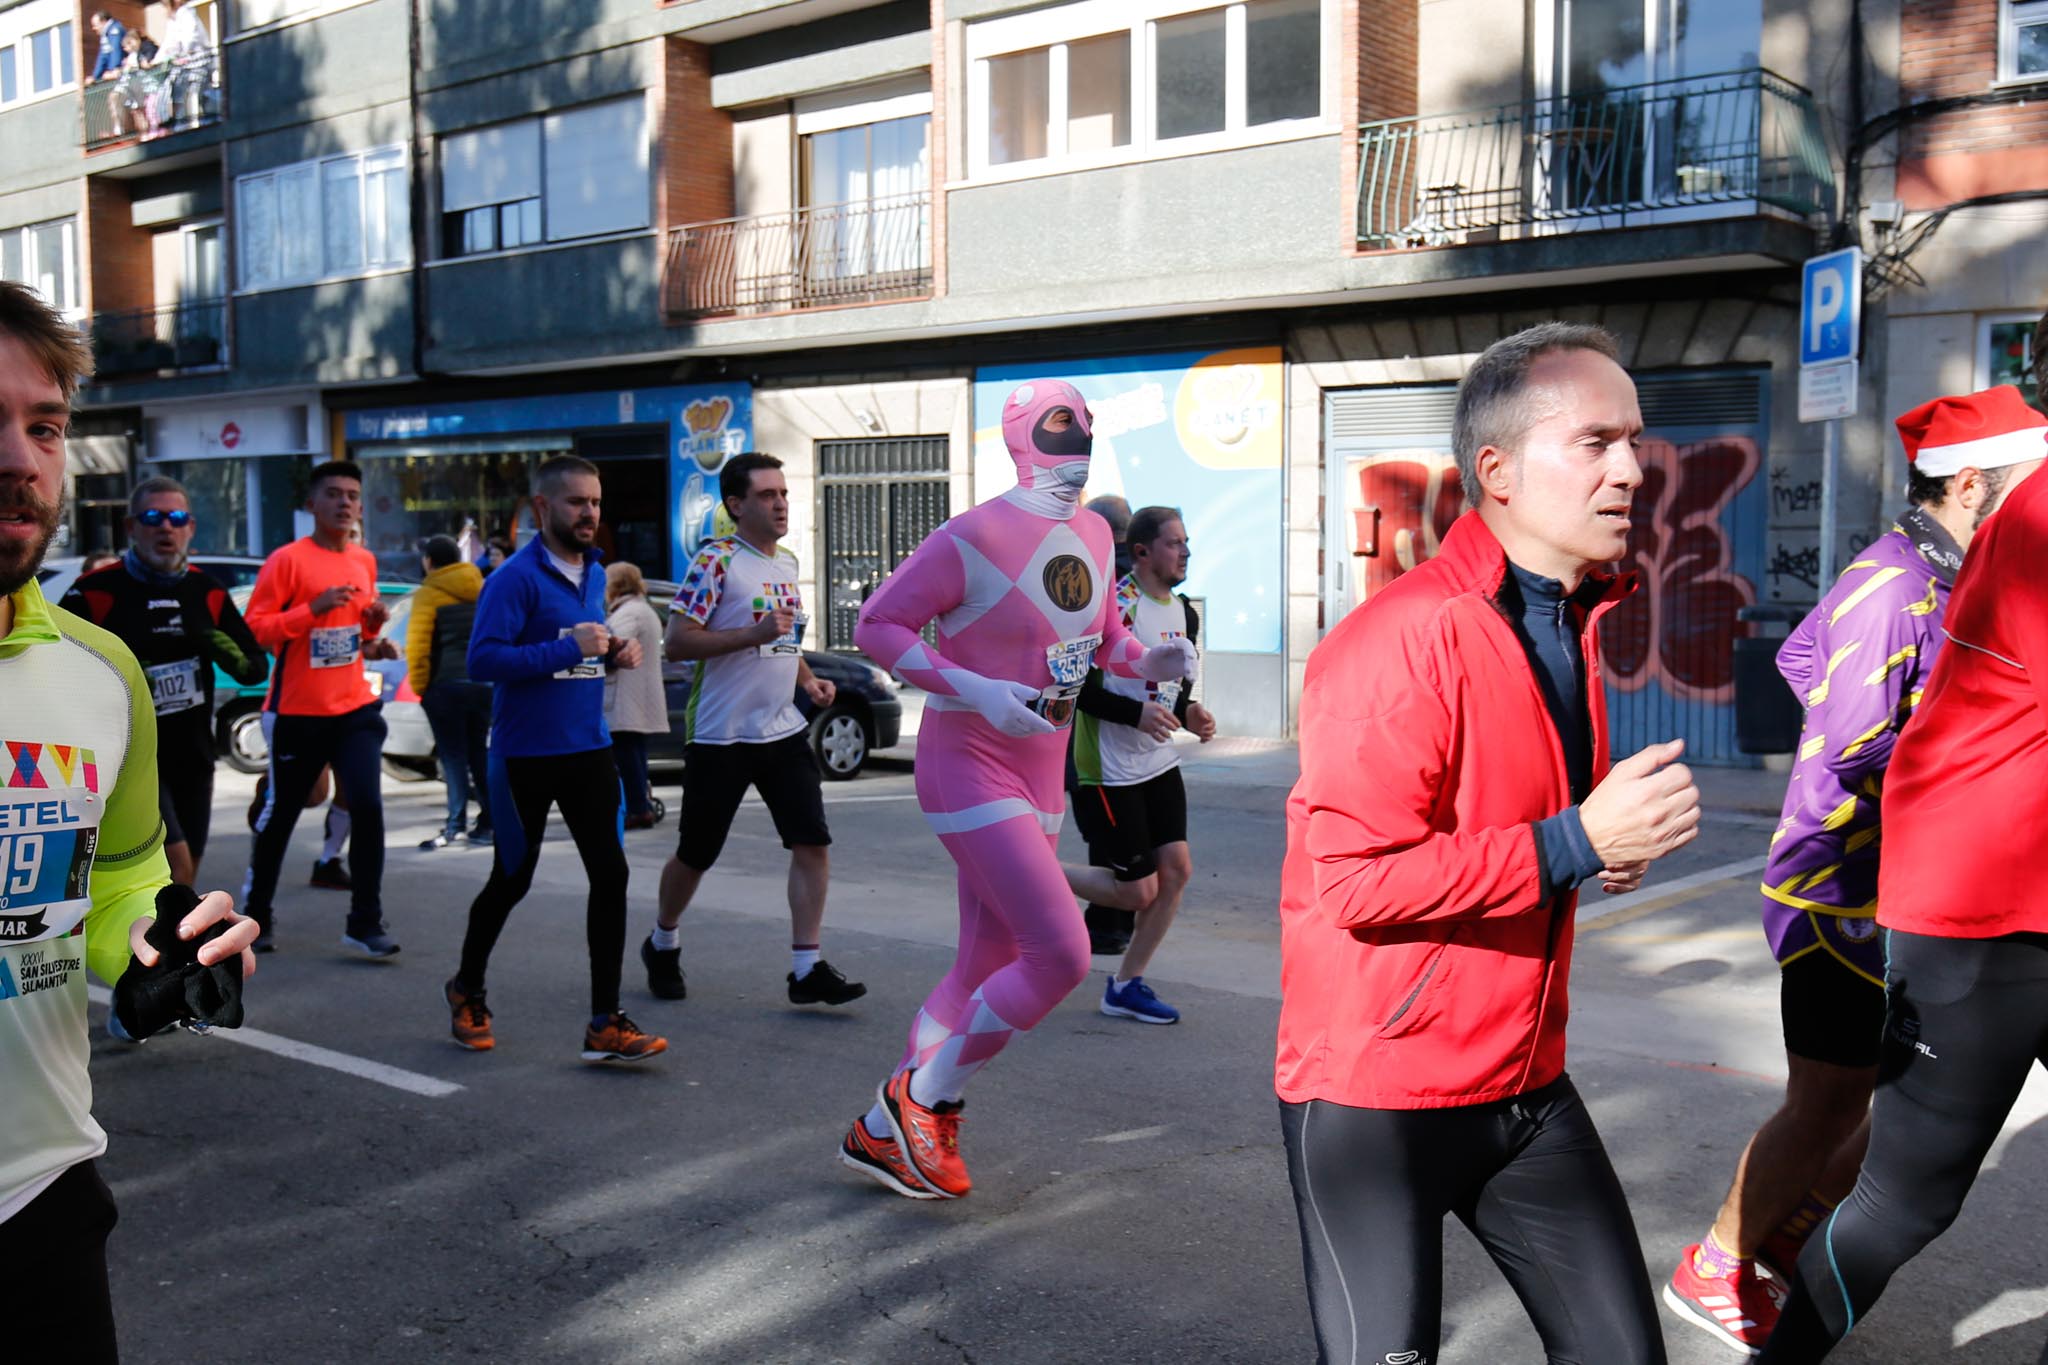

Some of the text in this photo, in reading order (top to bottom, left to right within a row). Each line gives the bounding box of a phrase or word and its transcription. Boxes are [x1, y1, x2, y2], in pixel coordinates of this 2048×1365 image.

[1810, 267, 1845, 353] P
[318, 639, 353, 656] 5665
[154, 673, 187, 700] 102
[20, 951, 44, 966] XXXVI
[20, 958, 81, 981] SAN SILVESTRE
